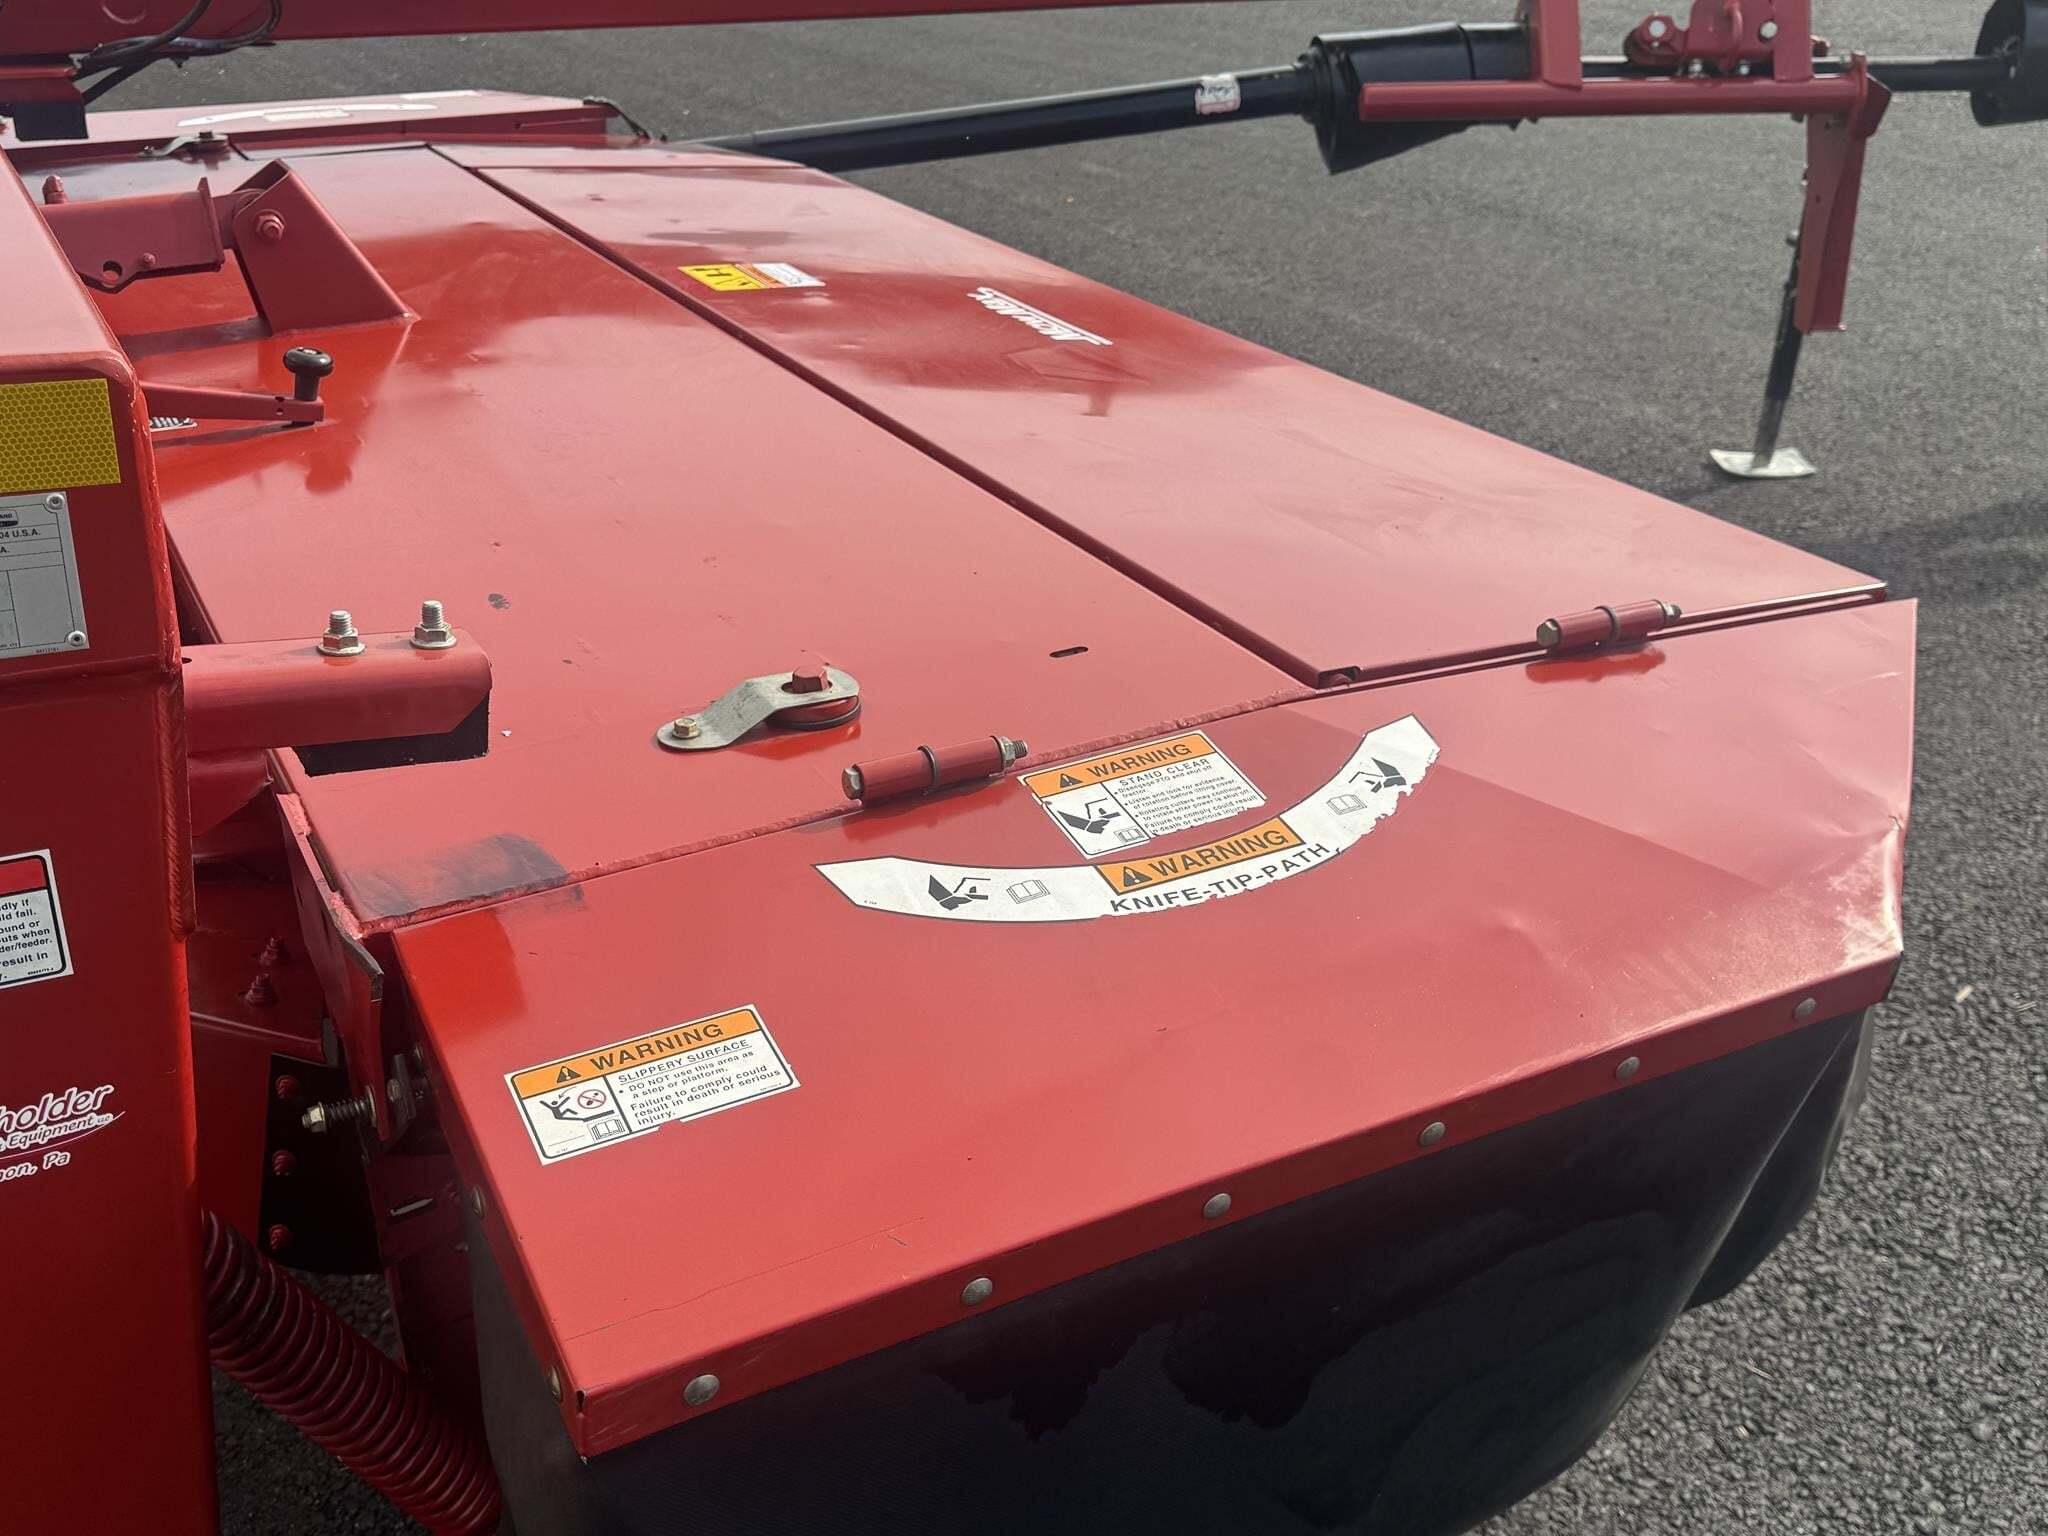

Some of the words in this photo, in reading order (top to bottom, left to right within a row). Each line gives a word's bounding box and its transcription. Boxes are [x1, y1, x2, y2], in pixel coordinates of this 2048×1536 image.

[12, 528, 41, 538] U.S.A.
[1087, 743, 1193, 777] WARNING
[1119, 769, 1162, 786] STAND
[1166, 758, 1210, 774] CLEAR
[1172, 771, 1185, 779] and
[1128, 794, 1151, 805] Listen
[1152, 790, 1165, 798] and
[1138, 804, 1170, 816] Rotating
[1170, 798, 1195, 807] cutters
[1211, 785, 1242, 797] continue
[1141, 795, 1170, 807] rotation
[1170, 789, 1194, 799] before
[1144, 817, 1173, 829] Failure
[1173, 814, 1182, 822] to
[1183, 807, 1212, 820] comply
[1212, 800, 1234, 811] could
[1235, 794, 1259, 804] result
[1152, 808, 1174, 819] rotate
[1175, 804, 1191, 813] after
[1192, 799, 1213, 809] power
[1160, 821, 1181, 832] death
[1193, 811, 1222, 823] serious
[1148, 830, 1289, 877] WARNING
[1110, 843, 1331, 912] KNIFE-TIP-PATH
[16, 908, 37, 918] fall.
[29, 920, 40, 928] or
[22, 927, 50, 939] when
[37, 951, 49, 961] in
[590, 1023, 724, 1070] WARNING
[618, 1057, 683, 1083] SLIPPERY
[686, 1039, 750, 1063] SURFACE
[628, 1081, 645, 1092] DO
[647, 1073, 671, 1086] NOT
[673, 1068, 693, 1079] use
[694, 1062, 715, 1073] this
[717, 1054, 740, 1066] area
[742, 1050, 754, 1058] as
[630, 1094, 672, 1111] Failure
[674, 1089, 688, 1098] to
[690, 1075, 732, 1094] comply
[735, 1064, 768, 1079] could
[634, 1102, 670, 1119] result
[671, 1097, 684, 1107] in
[686, 1087, 720, 1102] death
[723, 1083, 735, 1091] or
[738, 1069, 781, 1087] serious
[642, 1085, 666, 1096] step
[667, 1081, 679, 1089] or
[680, 1067, 729, 1085] platform.
[7, 1115, 95, 1148] Equipment
[636, 1110, 677, 1126] injury.
[43, 1151, 70, 1169] Pa
